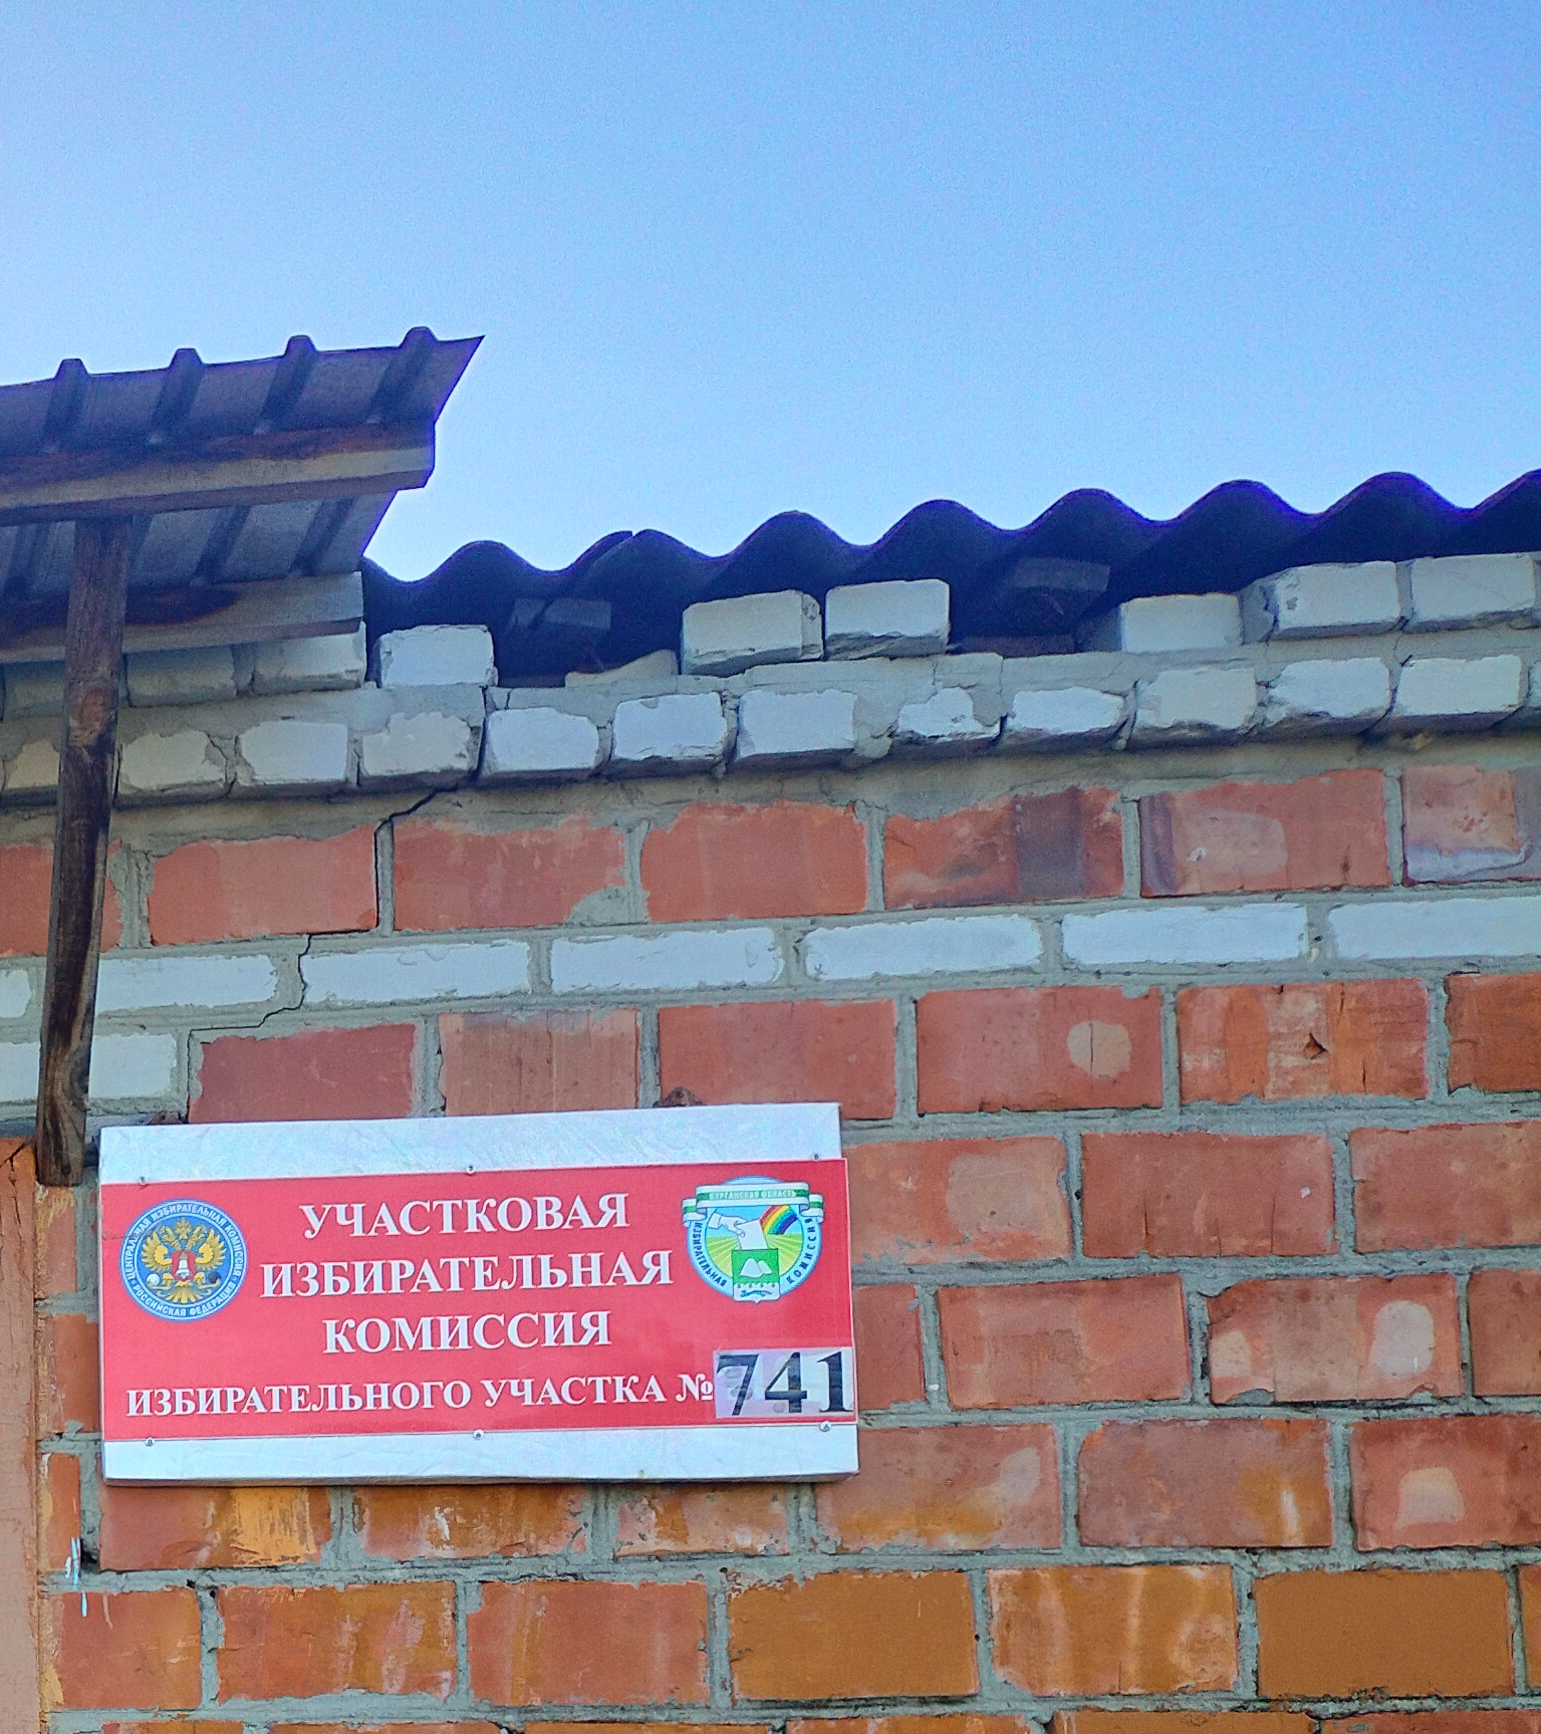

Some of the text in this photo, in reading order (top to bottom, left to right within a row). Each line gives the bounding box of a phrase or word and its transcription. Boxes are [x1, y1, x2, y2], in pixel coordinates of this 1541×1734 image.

[298, 1193, 630, 1239] УЧАСТКОВАЯ
[260, 1250, 674, 1298] ИЗБИРАТЕЛЬНАЯ
[692, 1218, 817, 1287] ИЗБИРАТЕЛЬНАЯ КОМИССИЯ
[323, 1311, 612, 1354] КОМИССИЯ
[125, 1381, 472, 1416] ИЗБИРАТЕЛЬНОГО
[481, 1375, 667, 1407] УЧАСТКА
